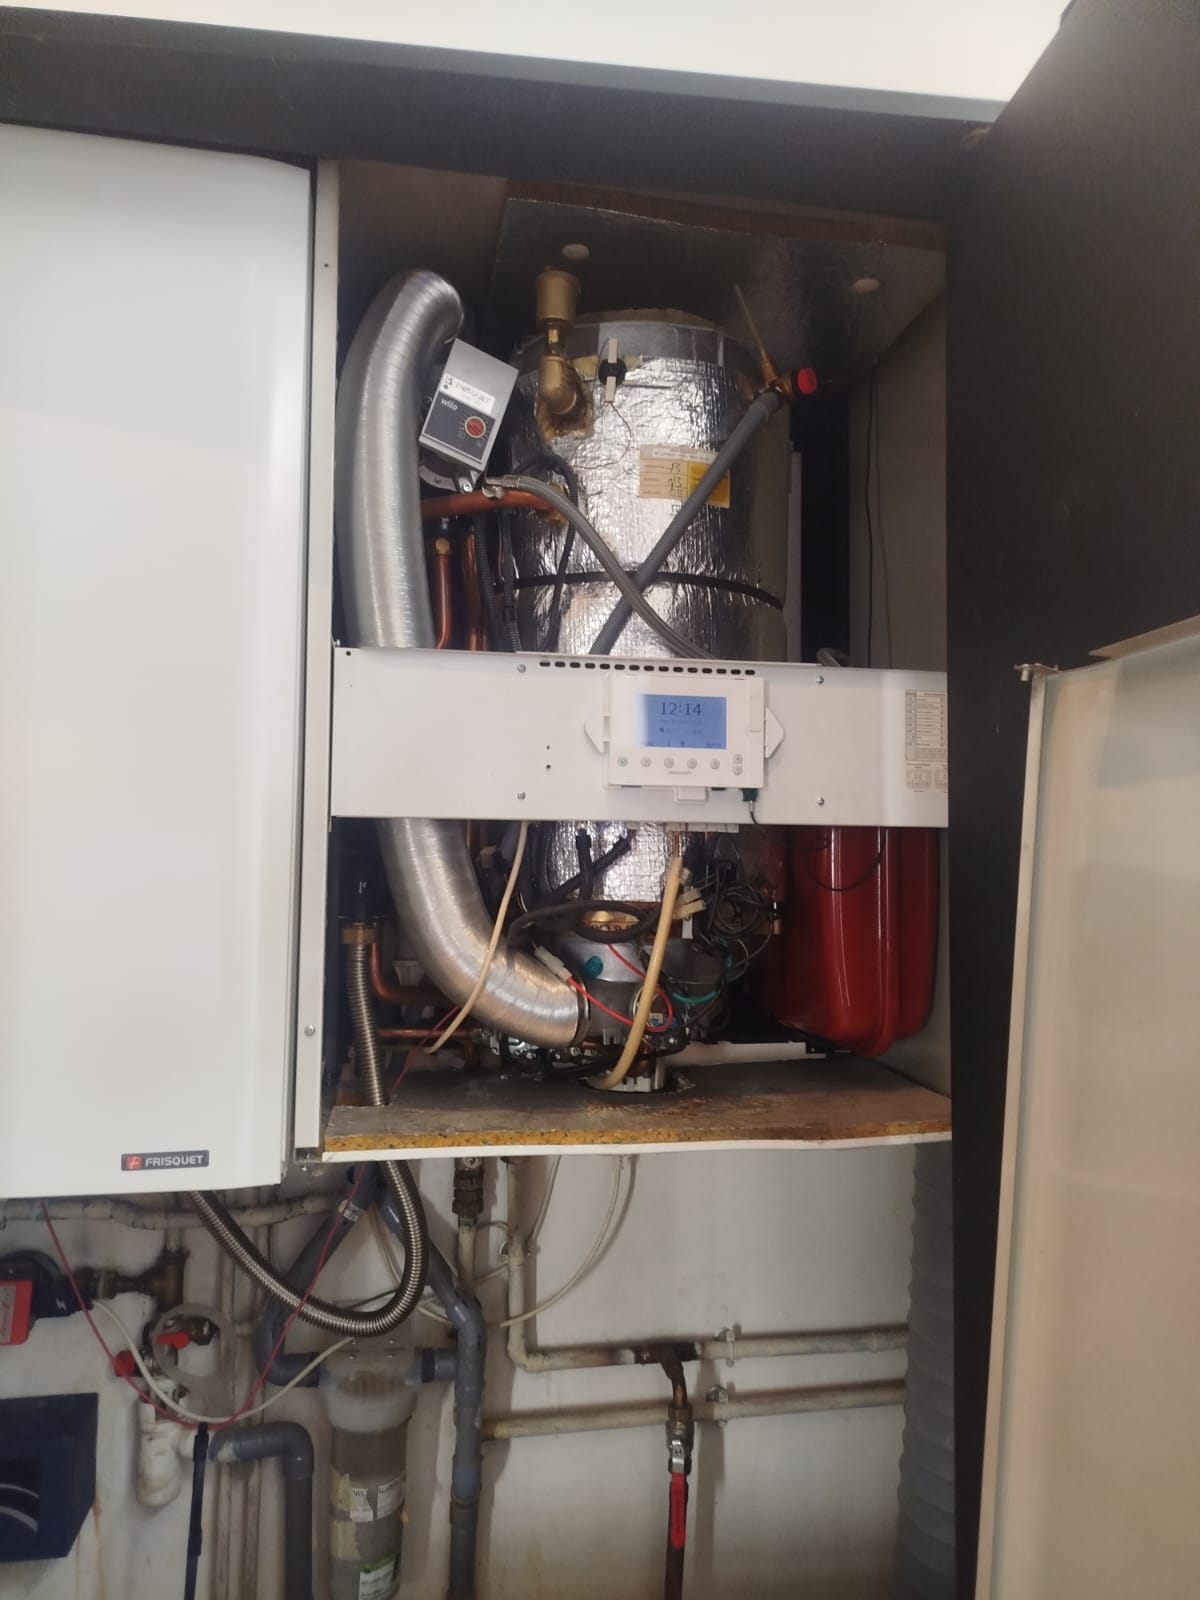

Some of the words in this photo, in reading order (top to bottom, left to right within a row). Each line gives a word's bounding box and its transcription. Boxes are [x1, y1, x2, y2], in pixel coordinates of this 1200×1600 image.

[440, 398, 458, 411] wilo
[661, 702, 702, 716] 12:14
[145, 1155, 204, 1167] FRISQUET
